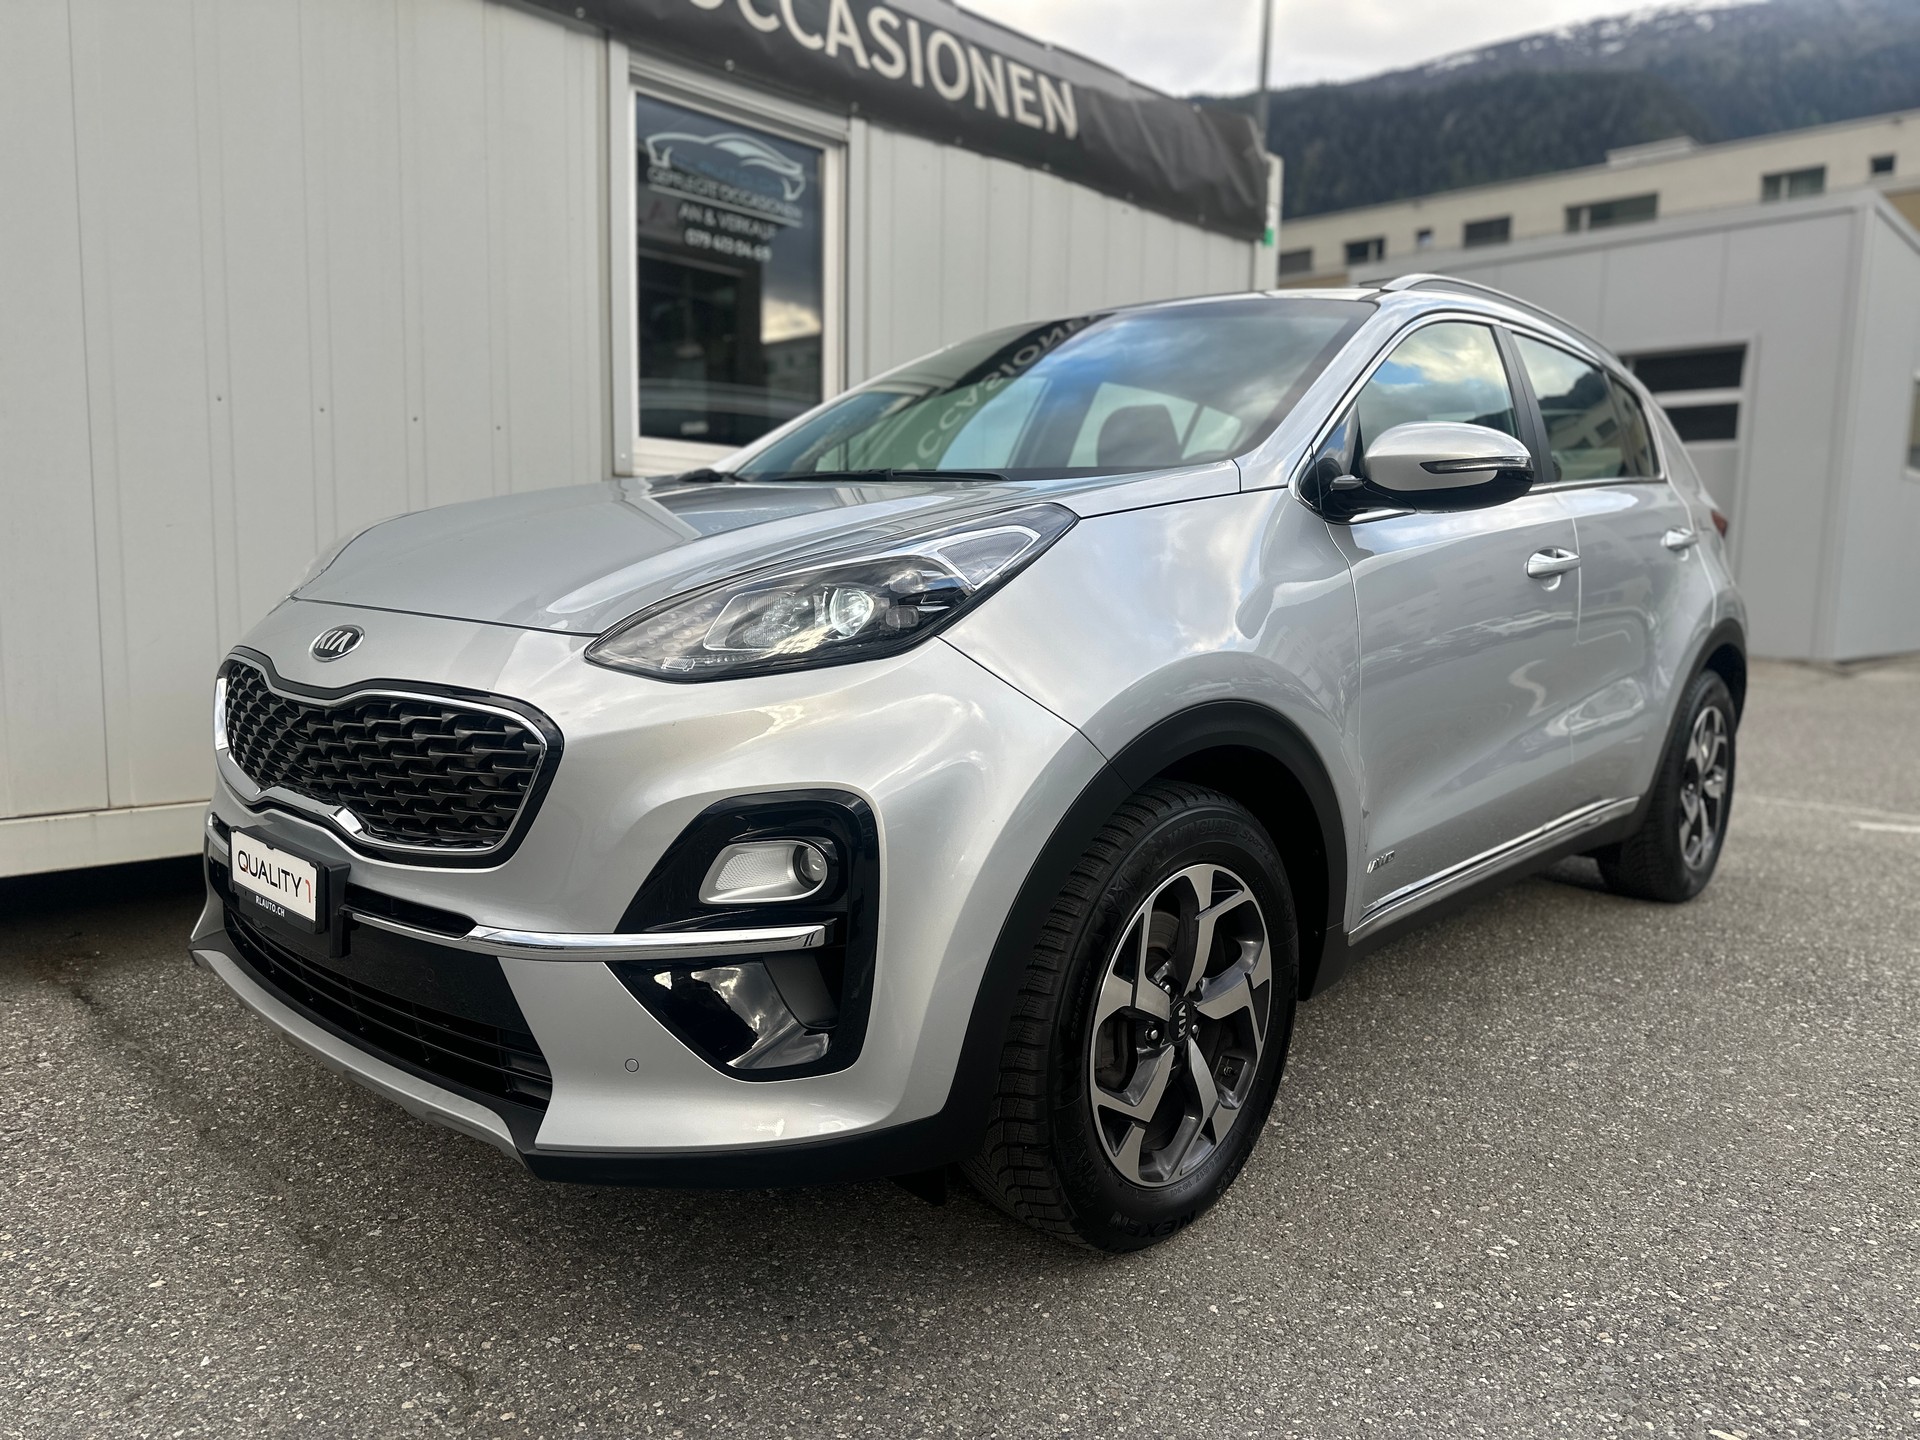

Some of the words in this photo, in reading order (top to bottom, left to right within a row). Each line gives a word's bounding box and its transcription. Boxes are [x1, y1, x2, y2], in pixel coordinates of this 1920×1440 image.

[690, 0, 1079, 140] CASIONEN
[678, 203, 703, 221] AN
[315, 630, 353, 653] KIA
[238, 850, 302, 897] QUALITY
[255, 895, 285, 917] RLAUTO.CH
[1178, 1004, 1187, 1039] KIA
